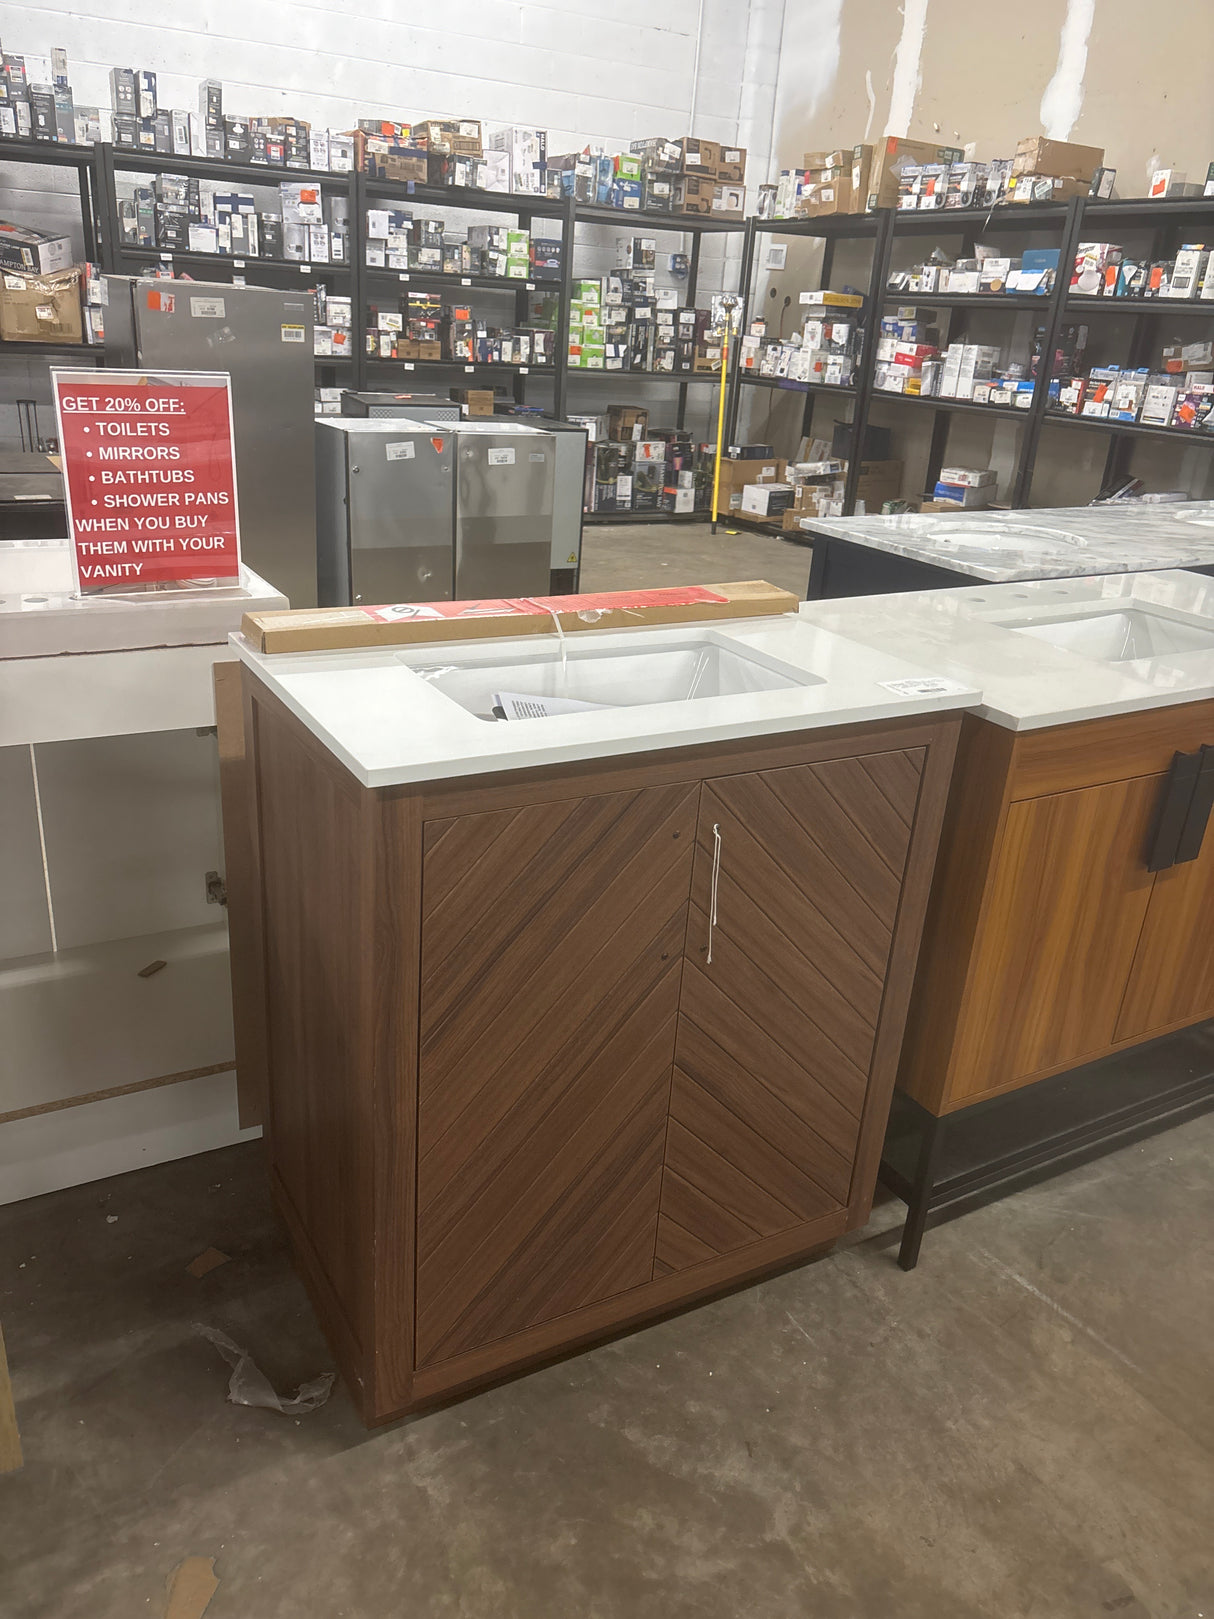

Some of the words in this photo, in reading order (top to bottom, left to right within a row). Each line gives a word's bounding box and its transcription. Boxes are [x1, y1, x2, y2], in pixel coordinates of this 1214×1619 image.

[27, 265, 39, 274] BAY
[62, 397, 100, 411] GET
[105, 397, 141, 411] 20%
[145, 398, 184, 412] OFF:
[95, 422, 170, 436] TOILETS
[99, 446, 180, 460] MIRRORS
[101, 470, 194, 484] BATHTUBS
[104, 493, 180, 508] SHOWER
[185, 491, 229, 505] PANS
[76, 517, 129, 532] WHEN
[133, 517, 170, 530] YOU
[174, 515, 209, 529] BUY
[78, 540, 128, 555] THEM
[132, 539, 175, 553] WITH
[179, 536, 225, 550] YOUR
[81, 562, 144, 578] VANITY
